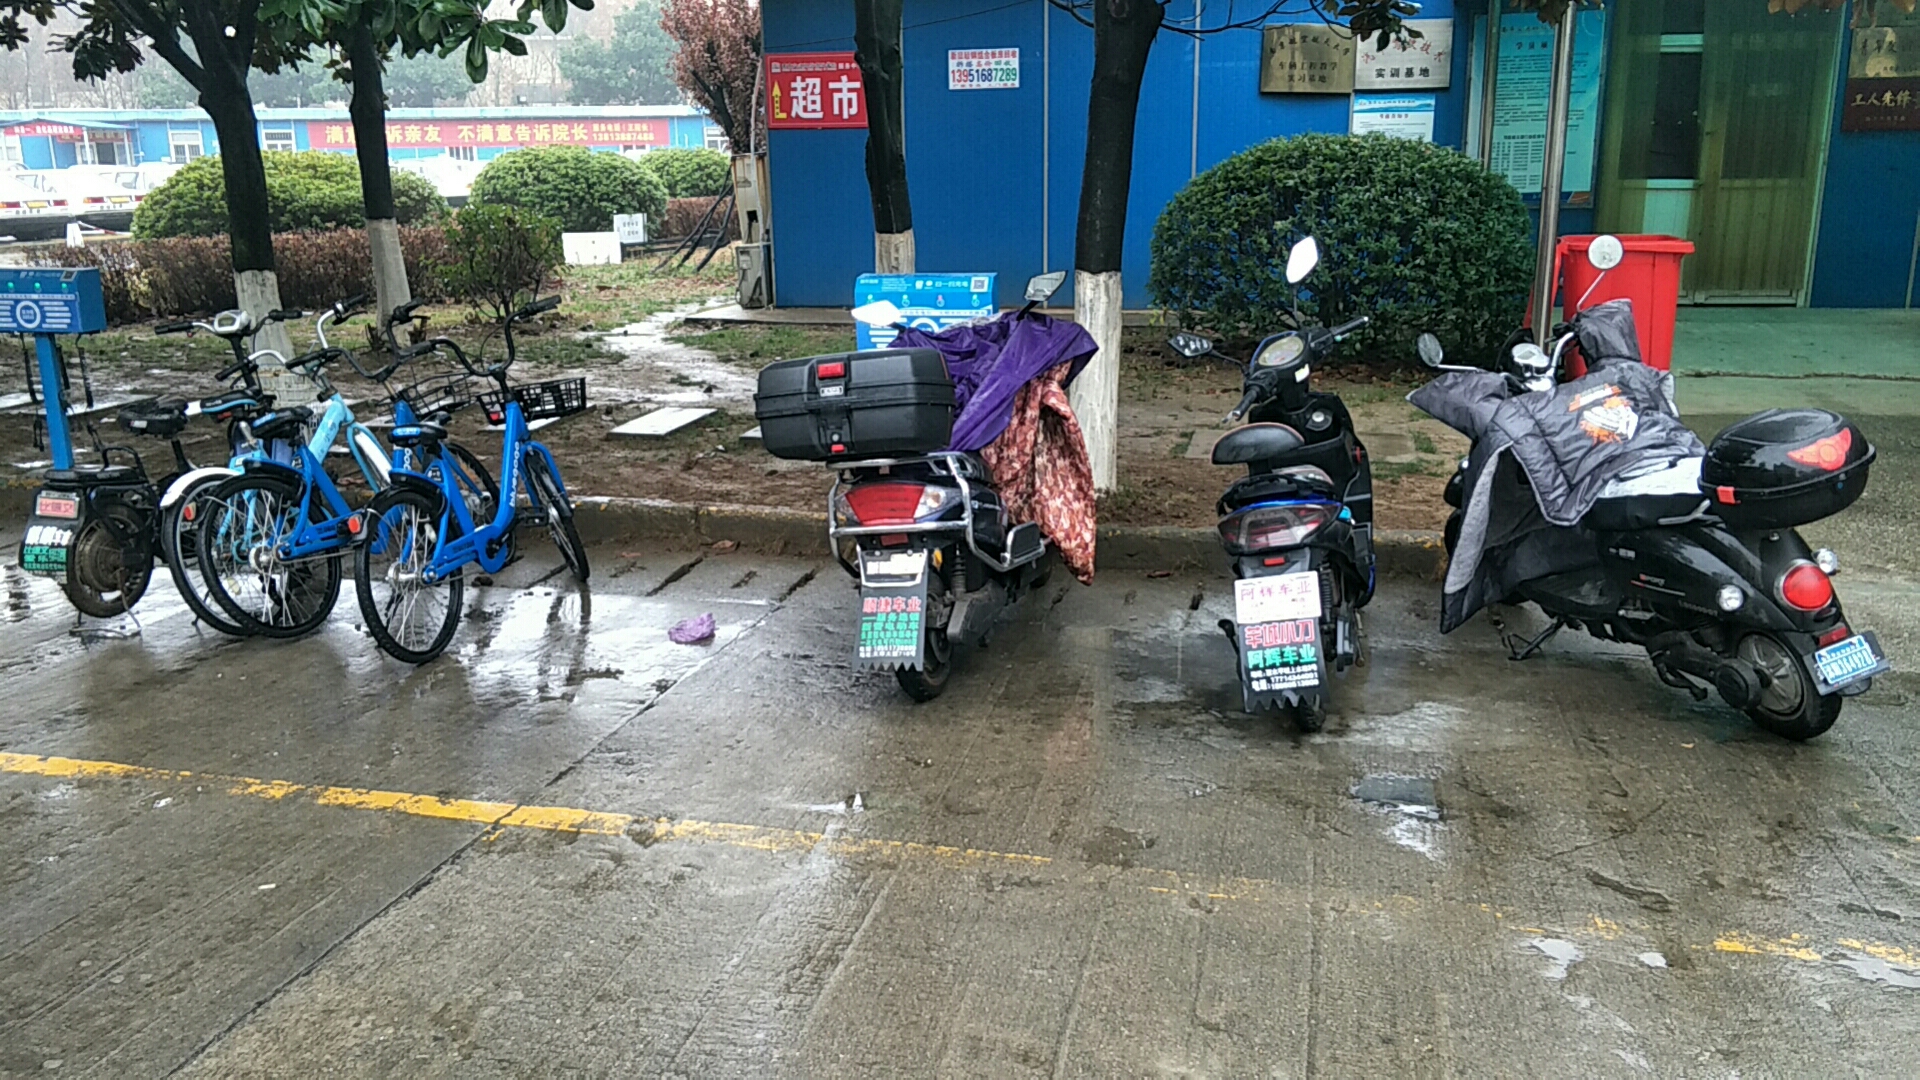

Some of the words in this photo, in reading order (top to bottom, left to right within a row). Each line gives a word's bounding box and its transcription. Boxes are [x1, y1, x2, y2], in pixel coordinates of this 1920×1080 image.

[951, 67, 1017, 83] 13951687289
[1287, 74, 1327, 83] 实习基地
[1375, 66, 1430, 79] 实训基地
[790, 75, 861, 119] 超市
[457, 124, 588, 142] 不满意告诉院长
[508, 441, 520, 508] bluegogo
[1247, 643, 1317, 669] 阿辉车业
